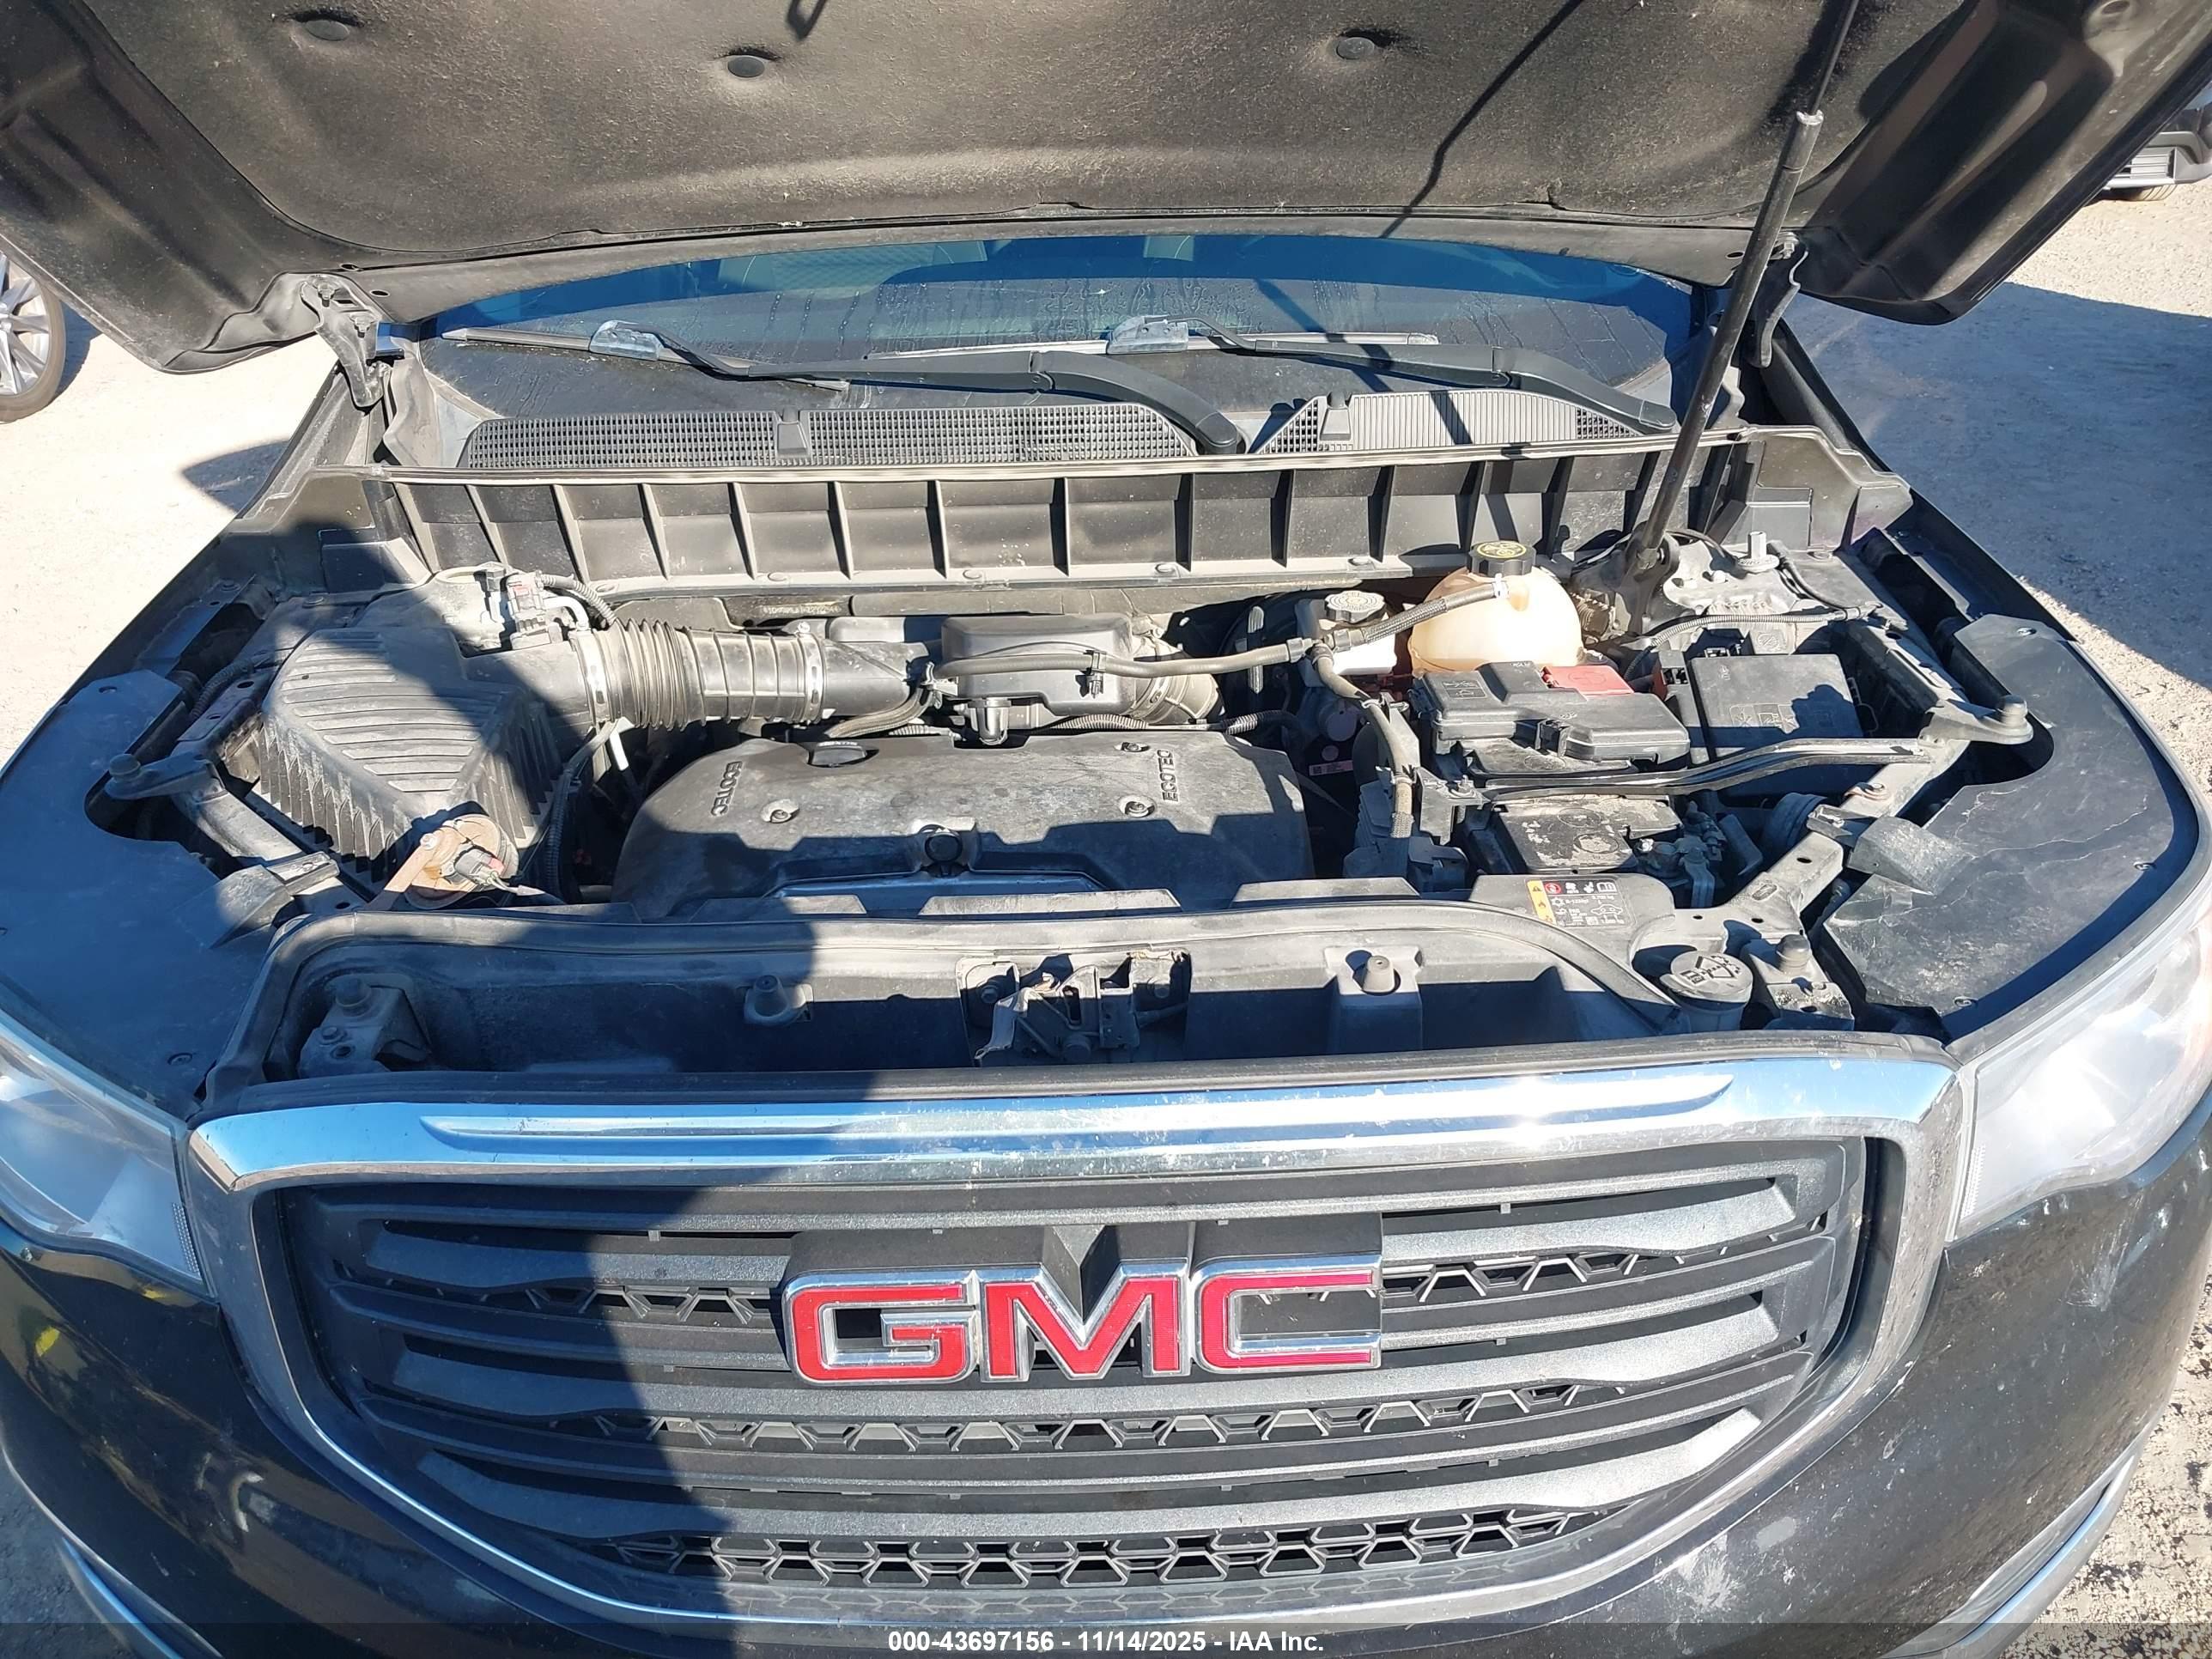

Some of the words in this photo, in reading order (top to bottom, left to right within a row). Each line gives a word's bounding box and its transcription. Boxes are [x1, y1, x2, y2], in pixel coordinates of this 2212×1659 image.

[710, 761, 742, 816] ECOTEC
[1157, 750, 1178, 801] ECOTEC
[781, 1255, 1382, 1385] GMC
